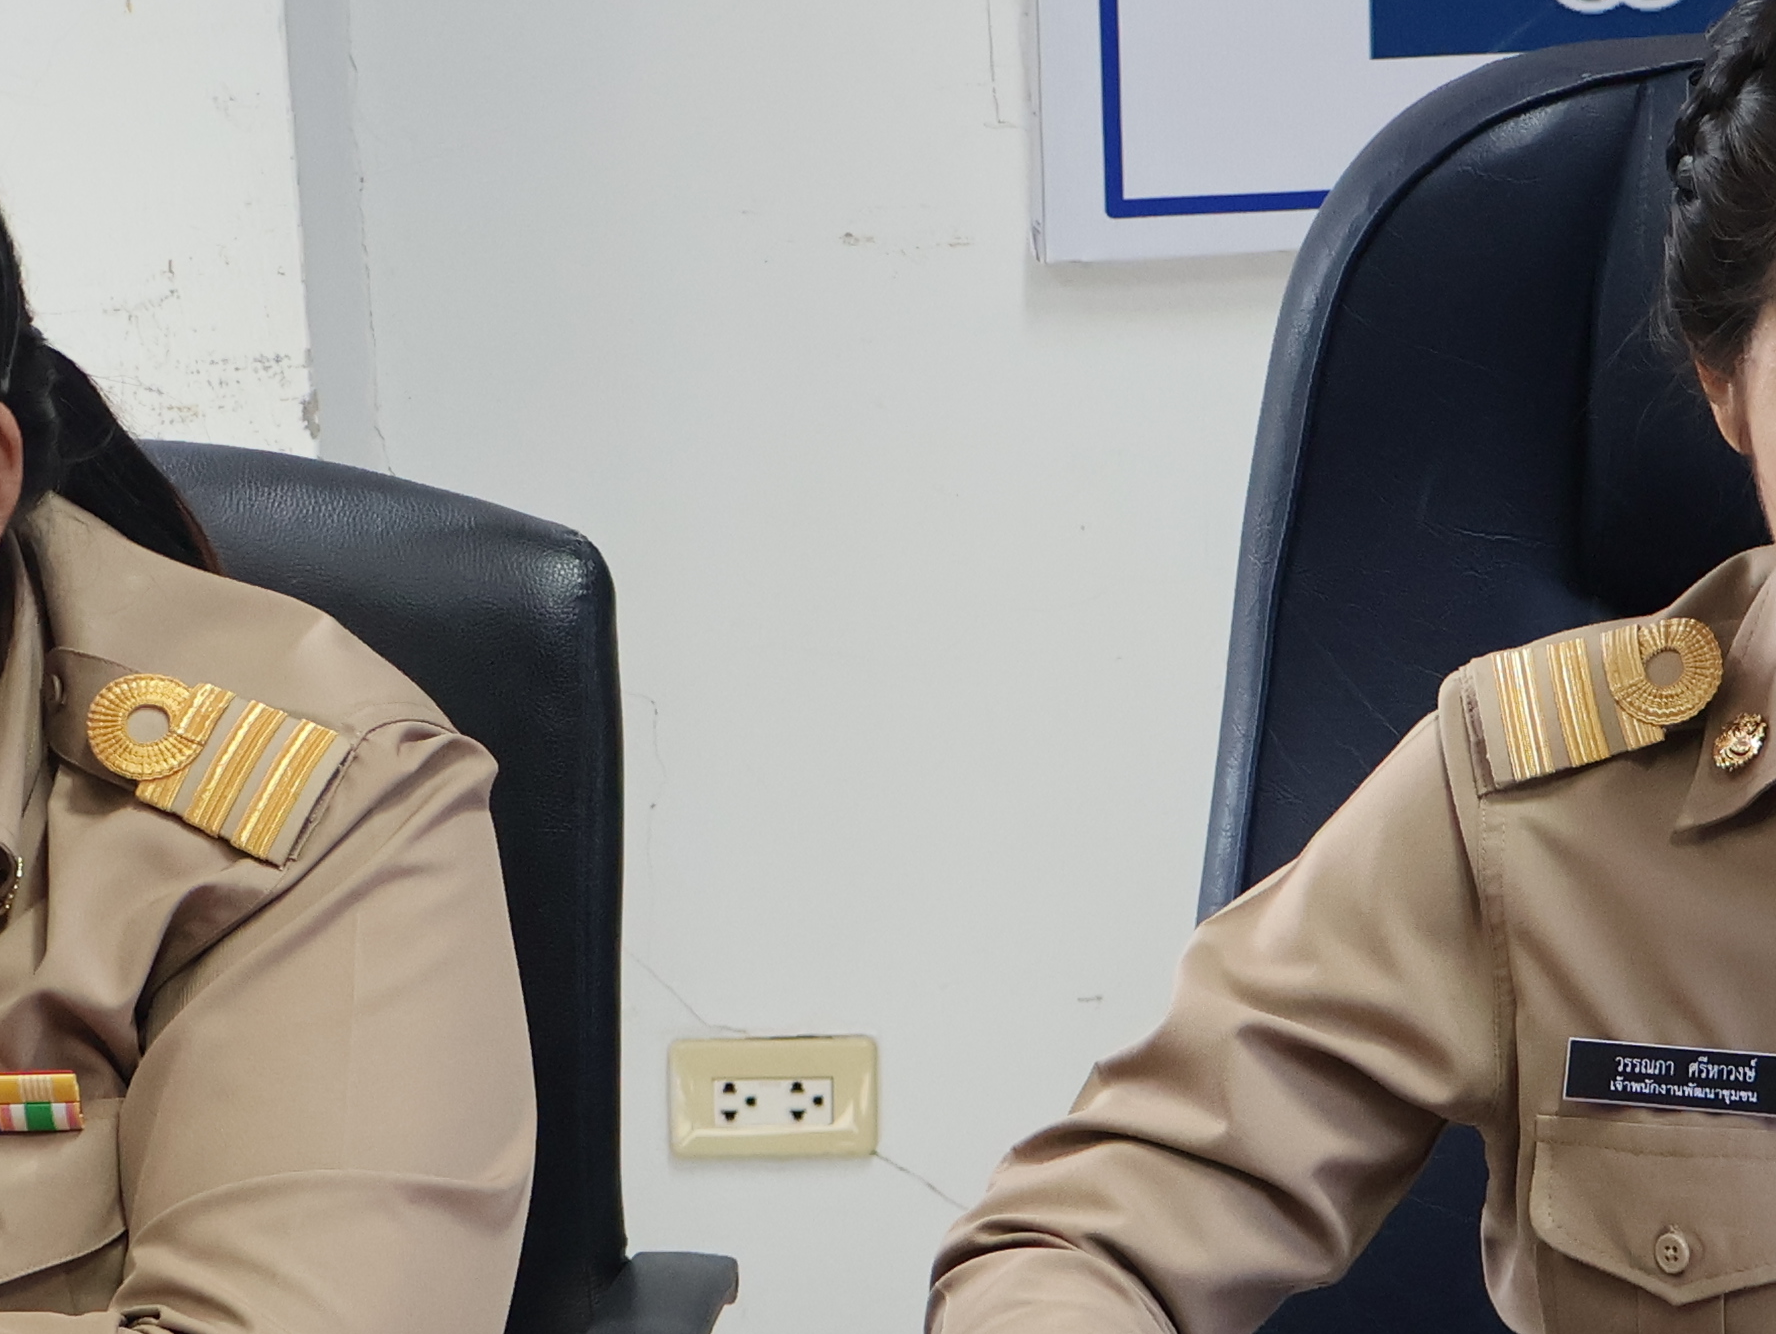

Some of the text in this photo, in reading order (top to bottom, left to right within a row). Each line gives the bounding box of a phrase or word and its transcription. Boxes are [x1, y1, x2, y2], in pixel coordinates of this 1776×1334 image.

[1615, 1056, 1674, 1076] วรรณภา
[1610, 1076, 1758, 1104] เจ้าพนักงานพัฒนาชุมชน
